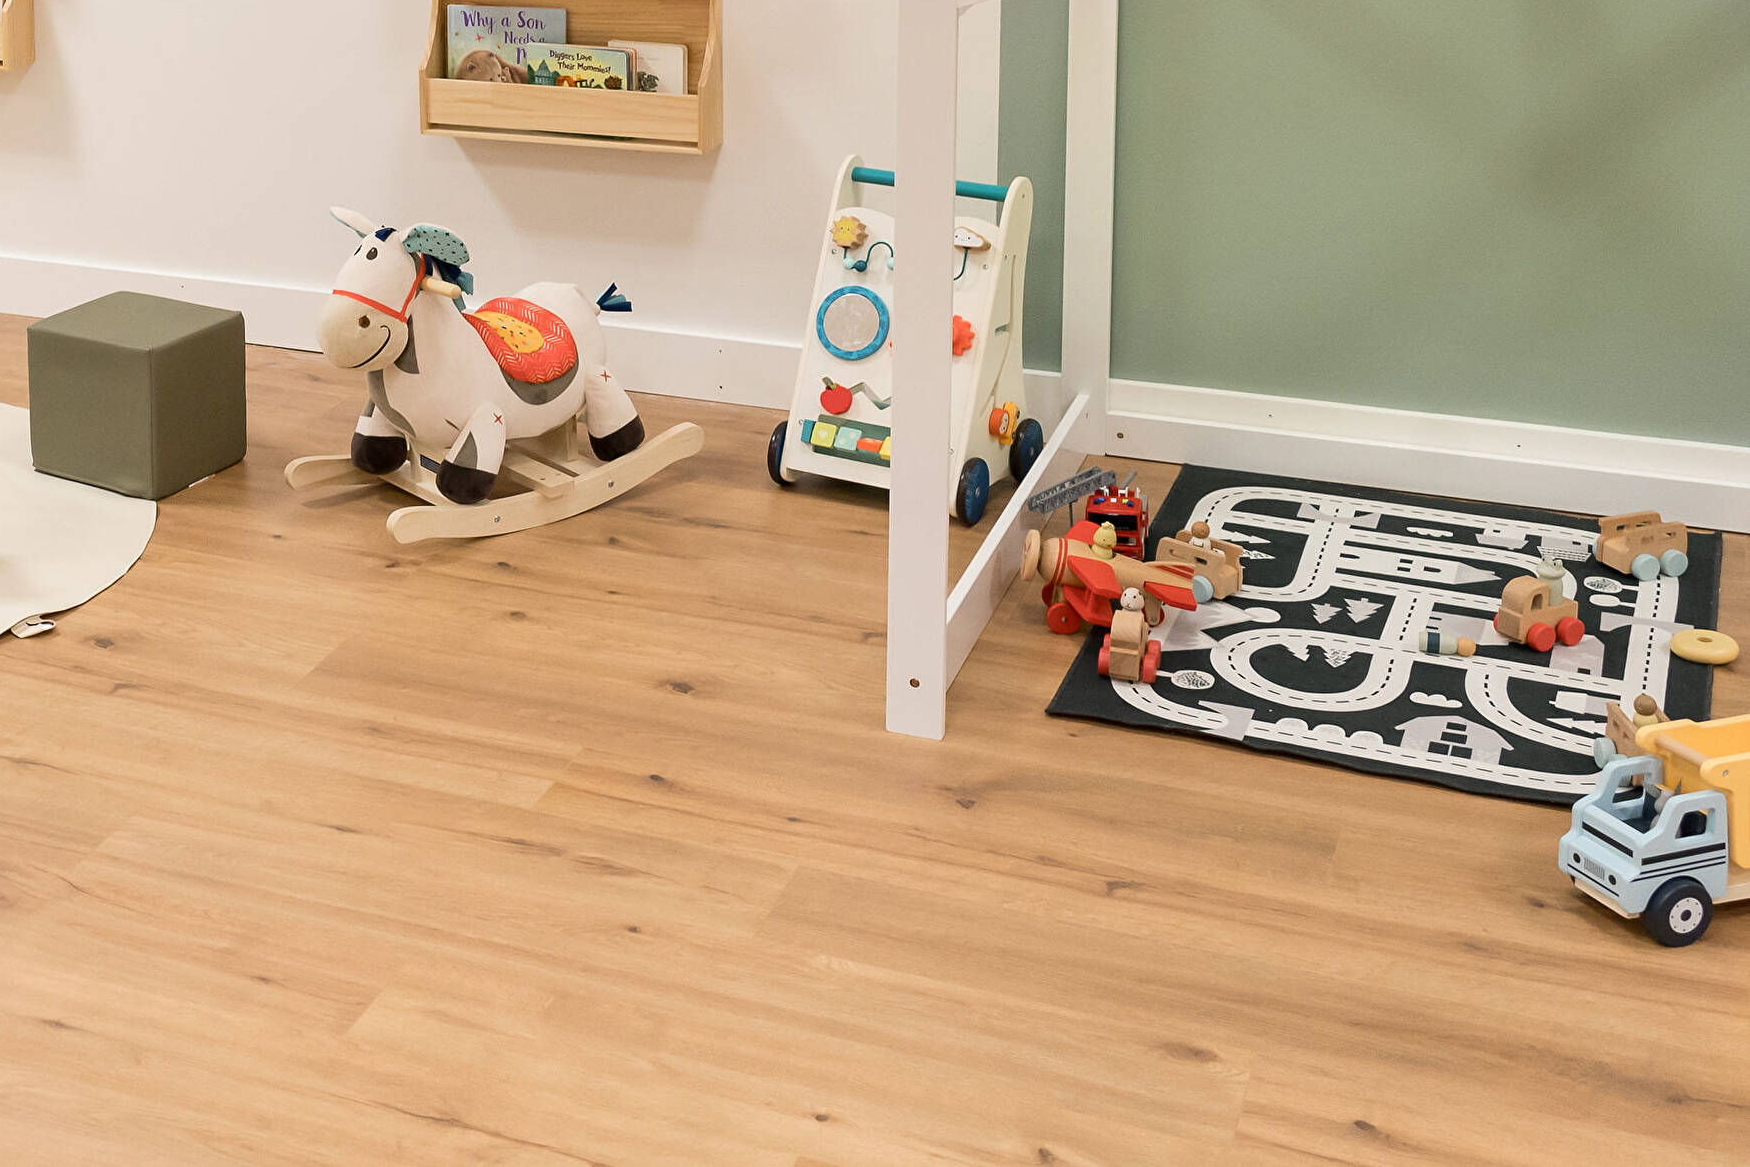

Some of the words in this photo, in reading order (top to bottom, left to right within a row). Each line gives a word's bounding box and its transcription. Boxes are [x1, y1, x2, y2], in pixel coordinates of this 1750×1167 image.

[460, 10, 493, 34] Why
[501, 17, 511, 27] a
[517, 10, 546, 30] Son
[504, 31, 536, 44] Needs
[549, 50, 575, 61] Diggers
[576, 53, 592, 62] Love
[558, 61, 575, 70] Their
